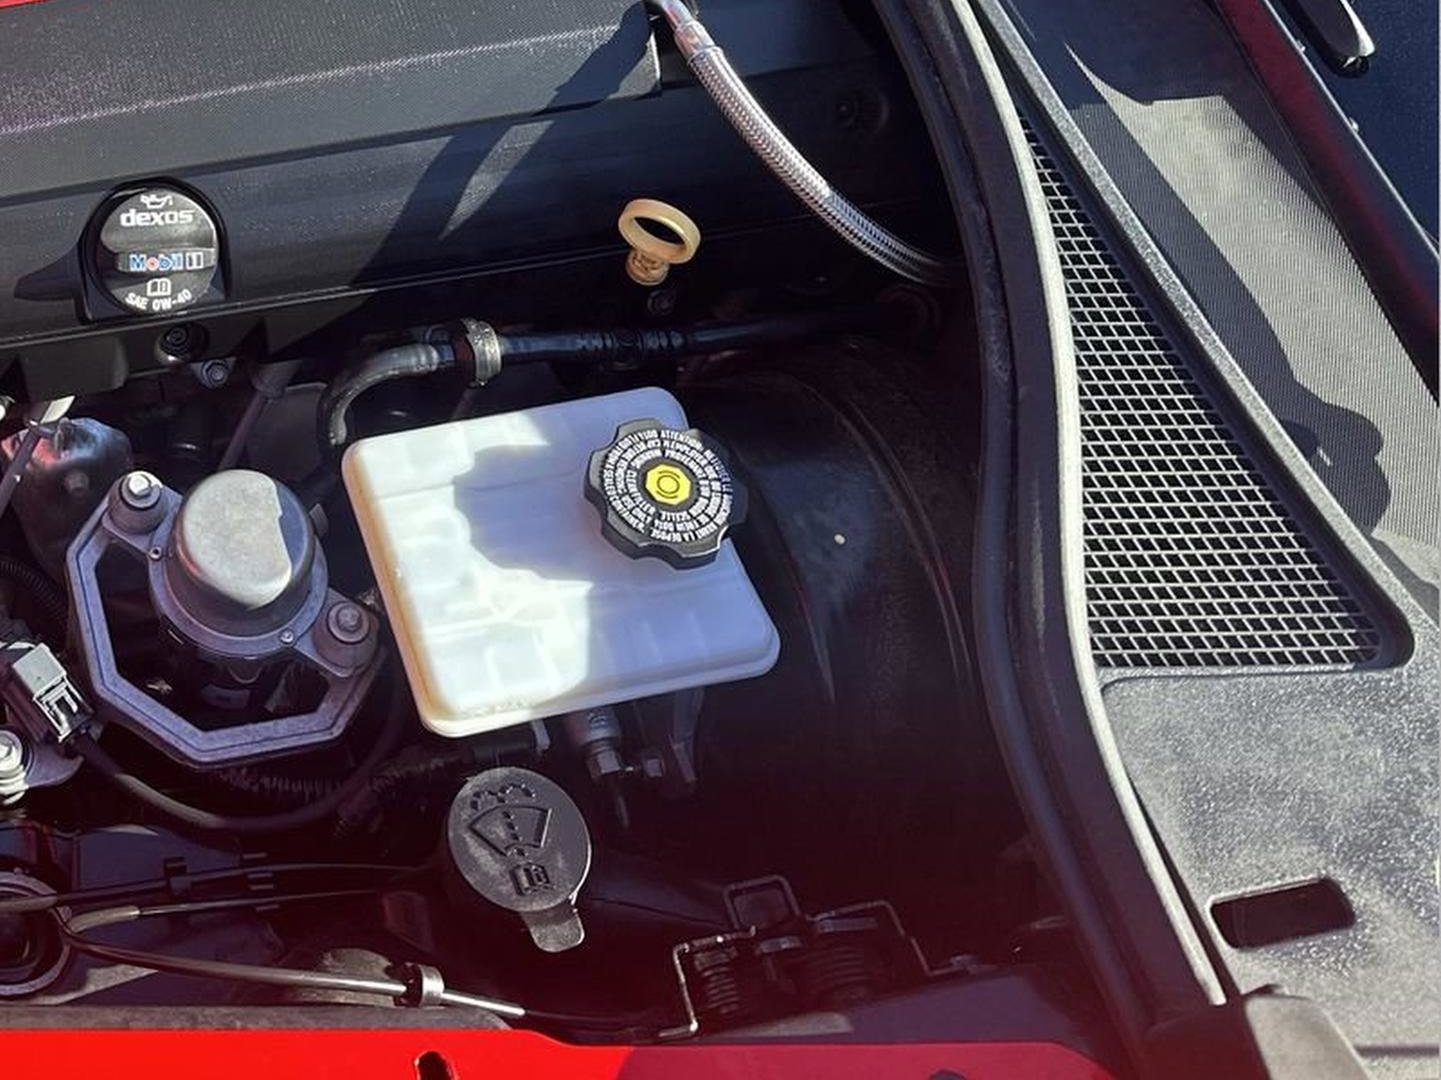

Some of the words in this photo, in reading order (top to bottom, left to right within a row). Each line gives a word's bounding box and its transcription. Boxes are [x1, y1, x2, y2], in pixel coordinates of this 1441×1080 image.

[120, 209, 194, 226] dexos
[129, 254, 184, 271] Mobil
[125, 293, 148, 310] SAE
[152, 289, 192, 311] 0W-40
